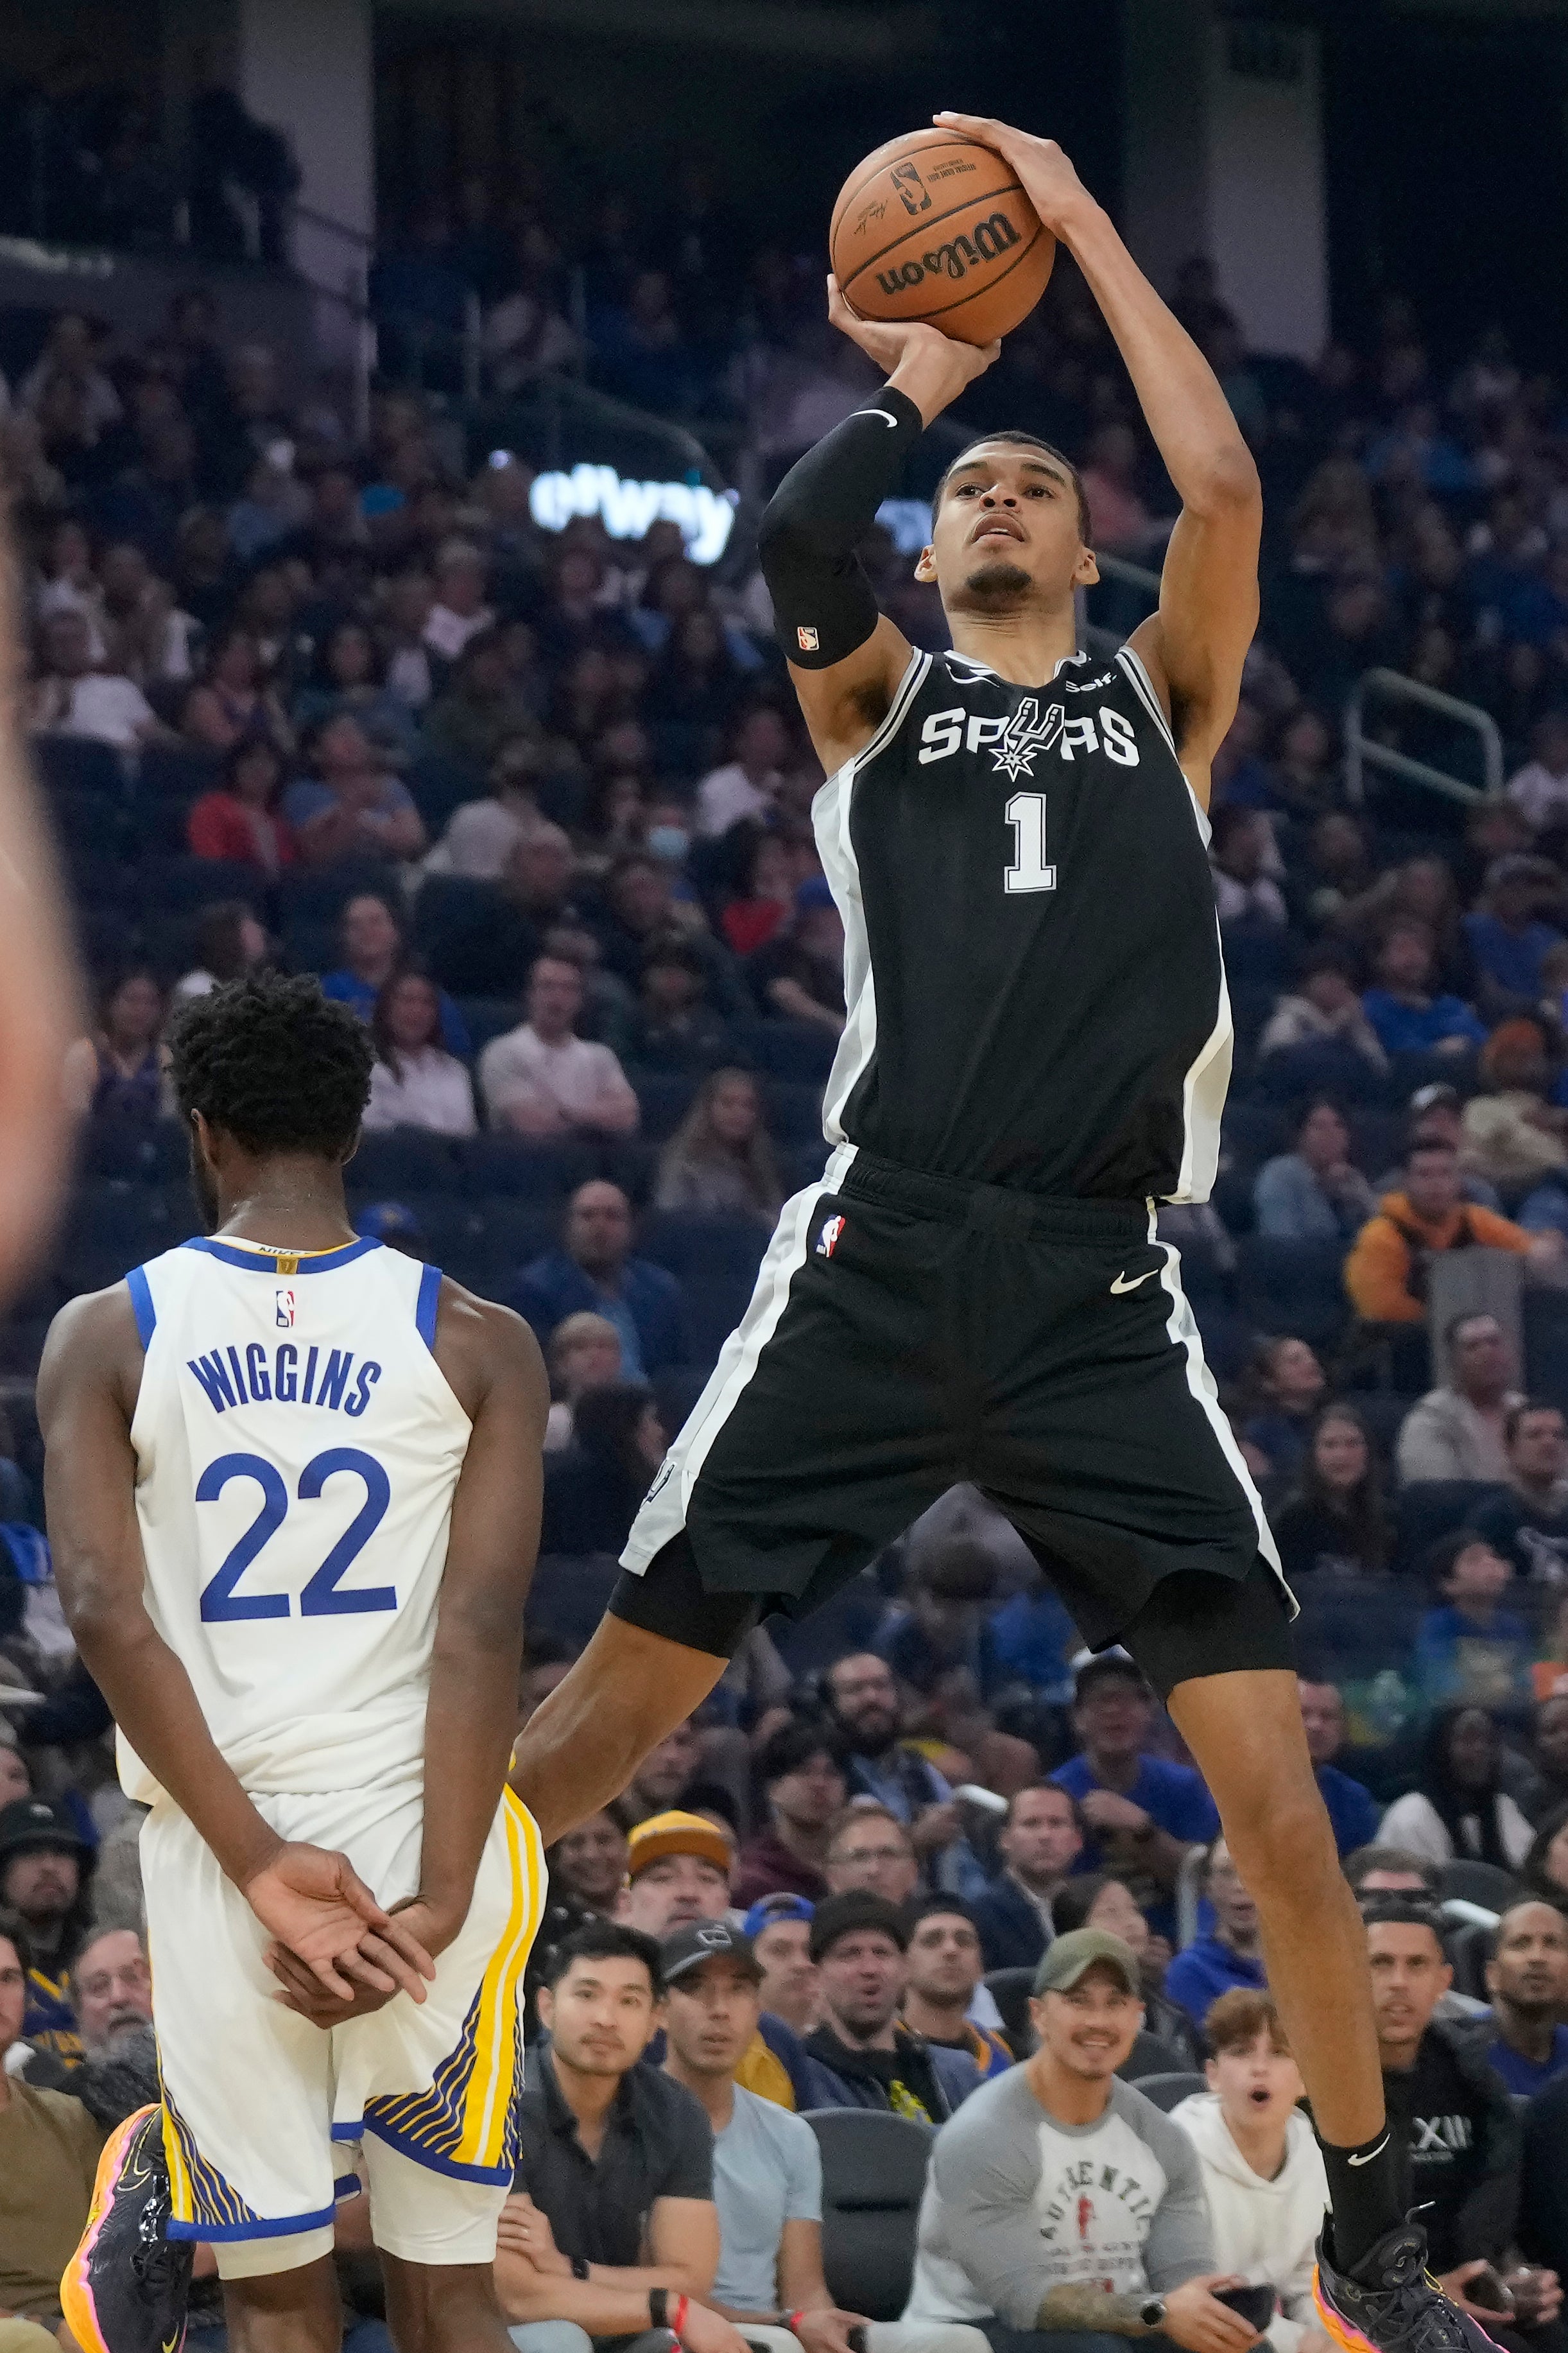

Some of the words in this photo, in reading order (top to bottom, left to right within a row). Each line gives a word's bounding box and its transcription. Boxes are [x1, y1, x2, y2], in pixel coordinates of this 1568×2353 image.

[875, 212, 1022, 295] Wilson
[918, 697, 1140, 782] SPURS
[1004, 792, 1056, 894] 1
[187, 1343, 381, 1417] WIGGINS
[195, 1448, 397, 1622] 22
